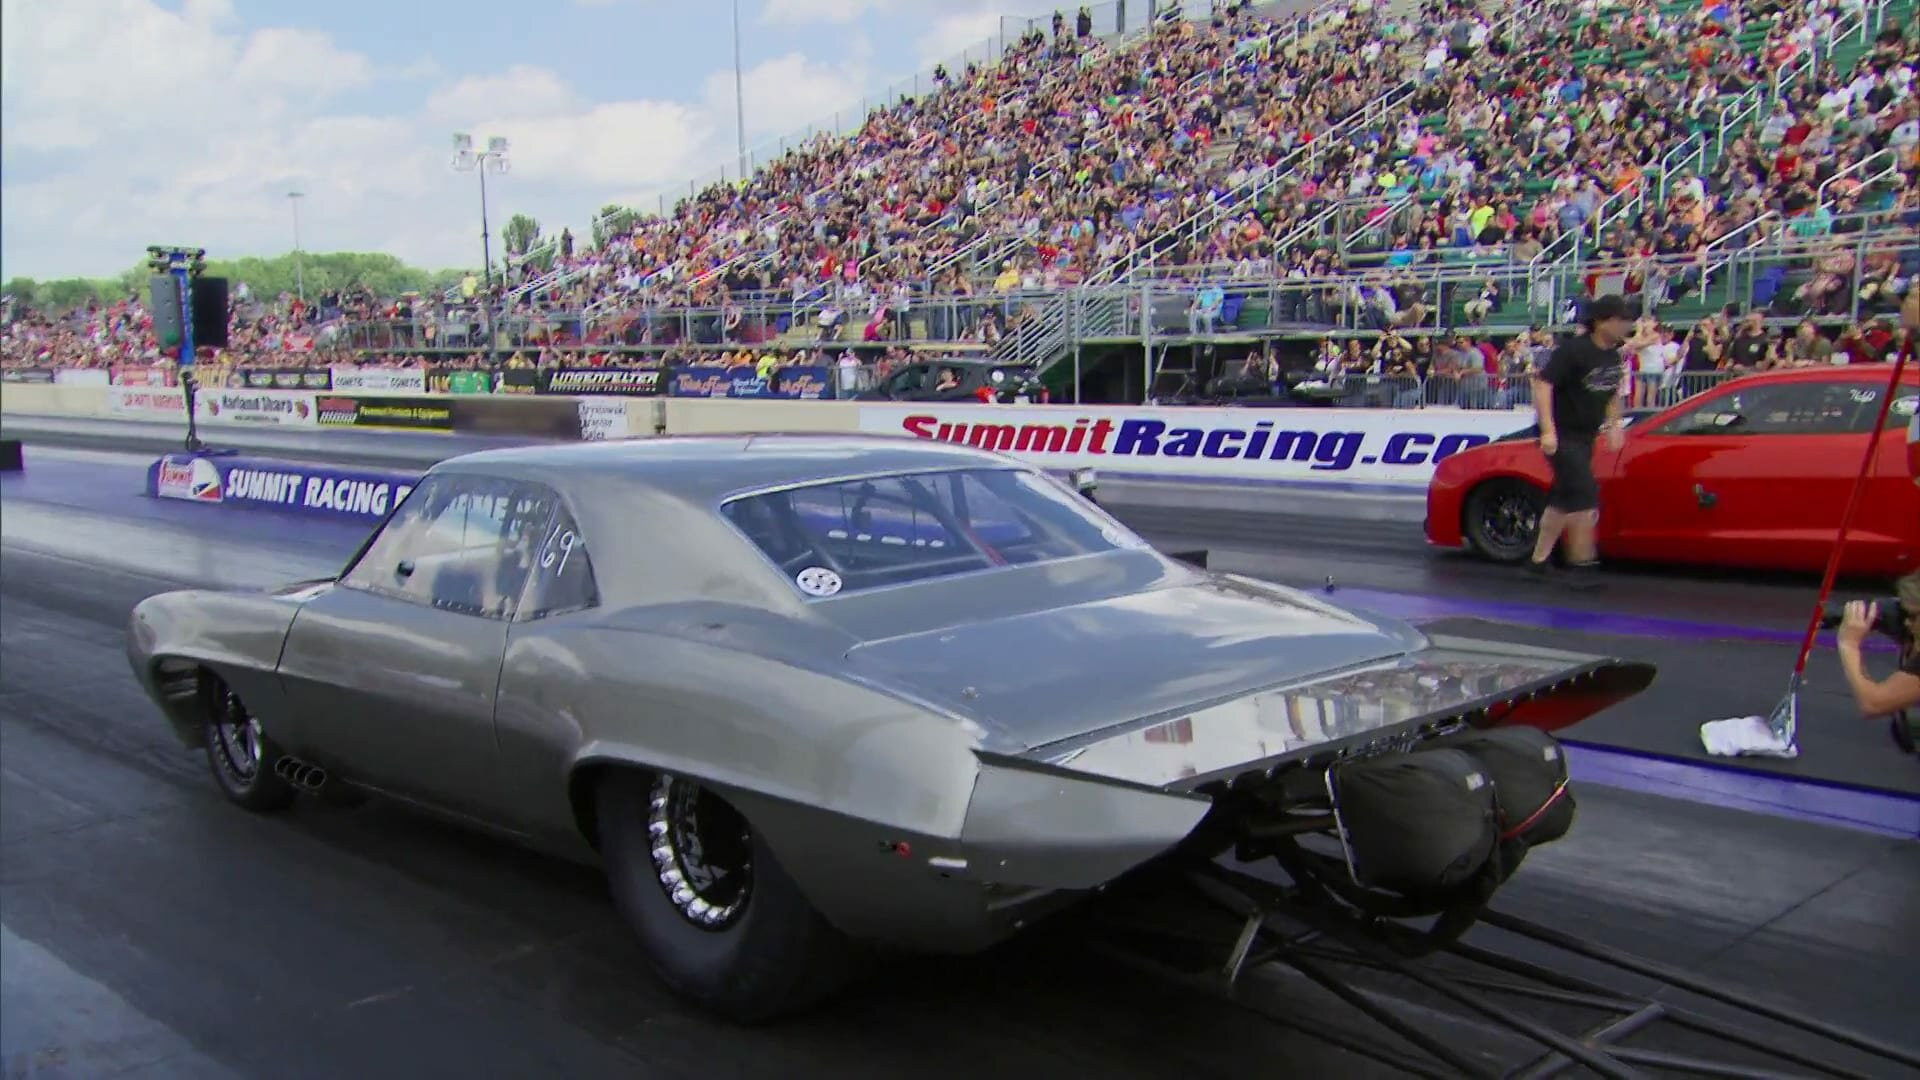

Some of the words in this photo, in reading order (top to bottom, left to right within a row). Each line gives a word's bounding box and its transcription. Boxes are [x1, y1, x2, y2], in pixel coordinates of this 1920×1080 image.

[221, 394, 260, 411] Harland
[262, 396, 293, 415] Sharp
[225, 467, 303, 504] SUMMIT
[304, 476, 390, 516] RACING
[541, 523, 576, 577] 69
